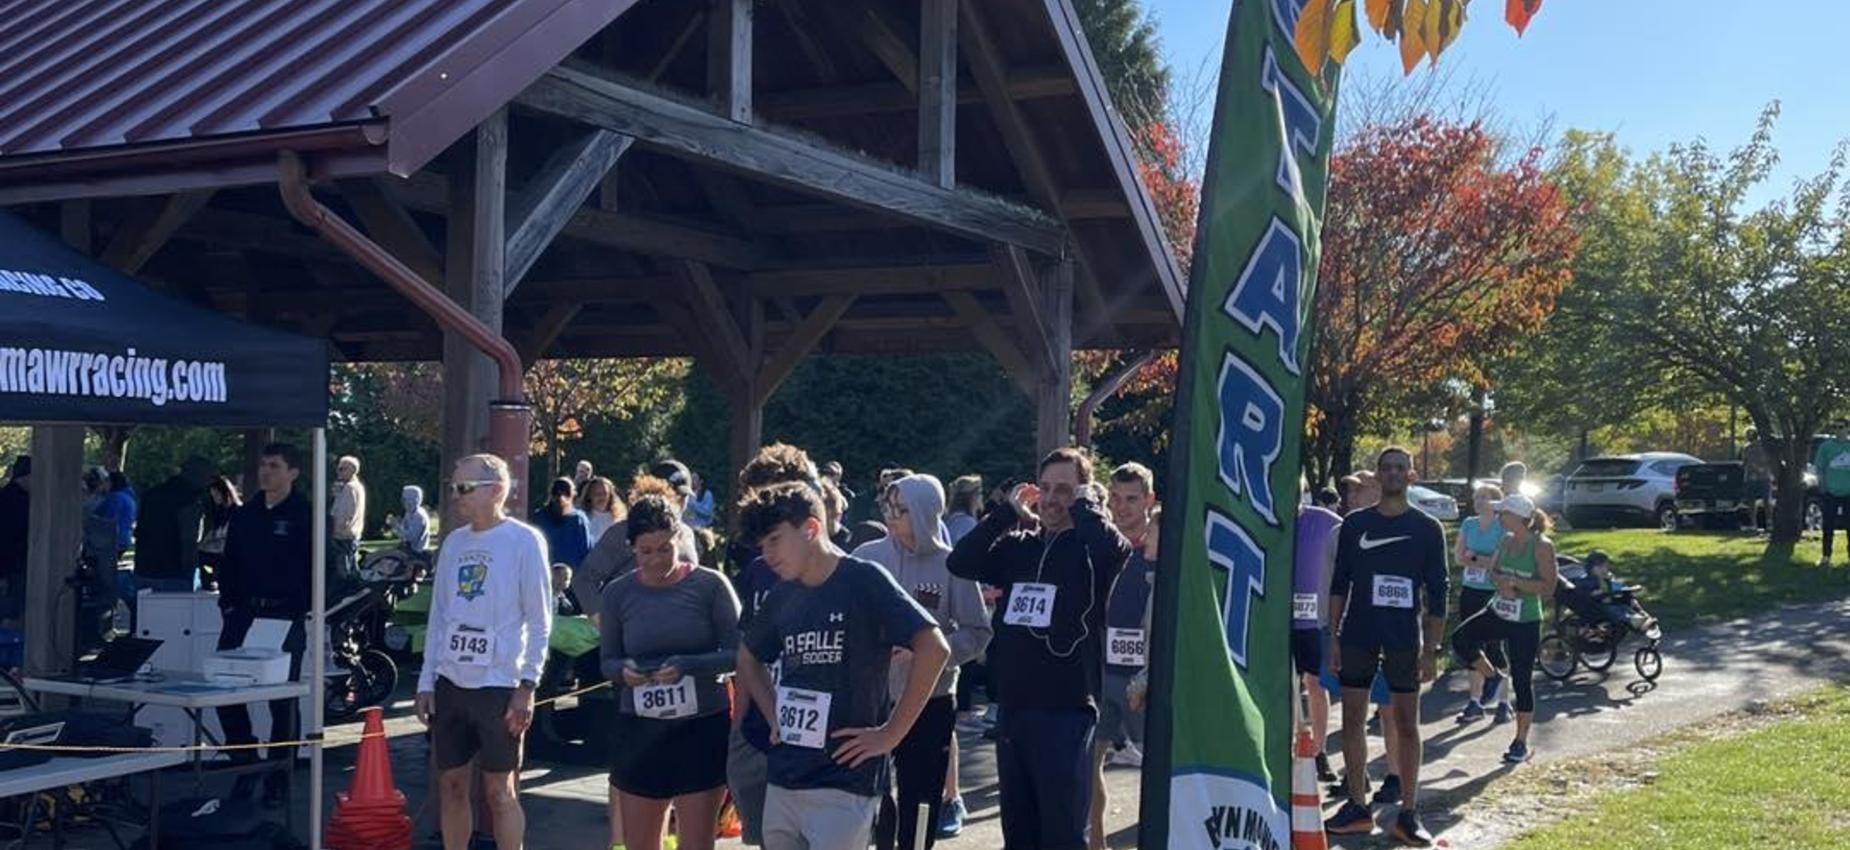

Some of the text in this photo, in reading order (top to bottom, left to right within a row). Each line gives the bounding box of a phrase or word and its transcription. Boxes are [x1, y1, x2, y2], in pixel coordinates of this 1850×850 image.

[1205, 0, 1322, 668] TART
[1012, 596, 1046, 615] 3614
[450, 634, 488, 654] 5143
[642, 685, 686, 709] 3611
[780, 705, 819, 731] 3612
